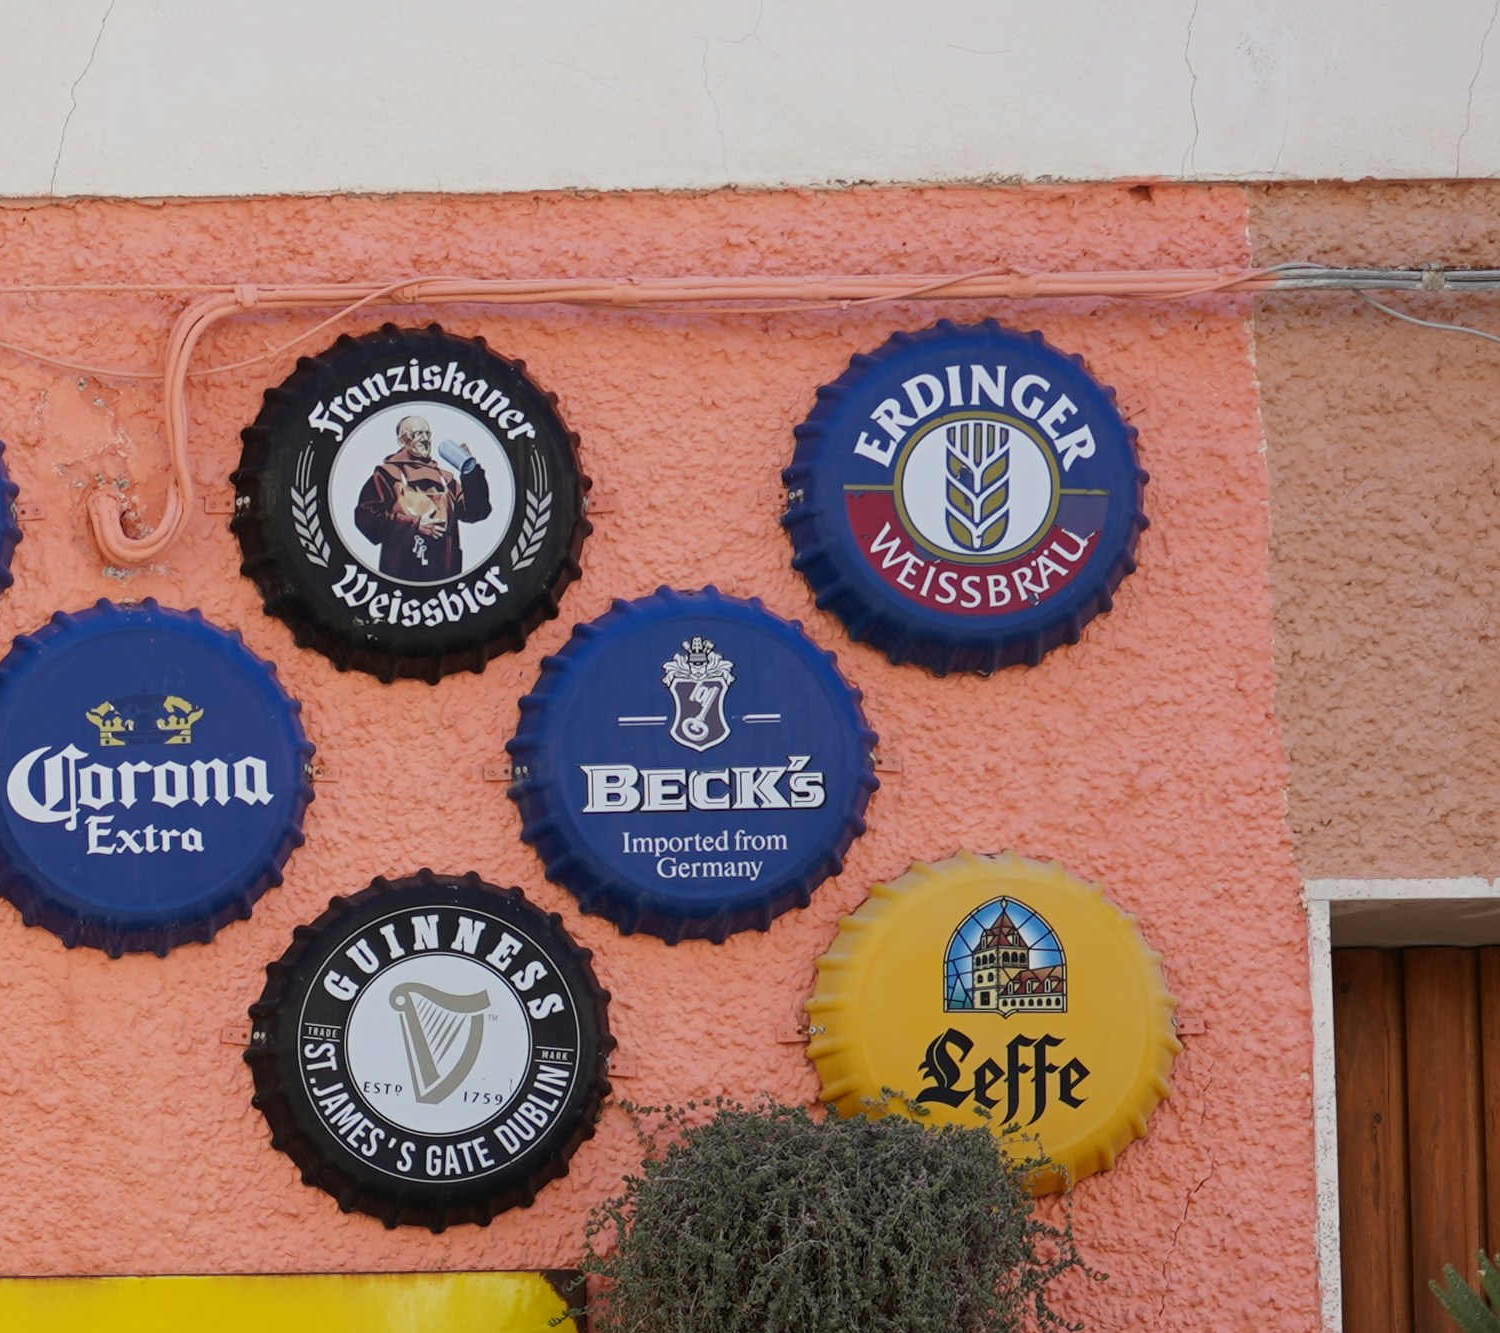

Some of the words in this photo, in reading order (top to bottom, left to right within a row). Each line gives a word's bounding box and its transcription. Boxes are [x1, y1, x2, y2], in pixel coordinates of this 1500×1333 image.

[308, 357, 537, 443] Franziskaner
[853, 364, 1096, 472] ERDINGER
[332, 563, 509, 628] Weissbier
[869, 520, 1093, 610] WEISSBRÄU
[7, 742, 274, 831] Corona
[85, 815, 204, 857] Extra
[622, 831, 727, 854] Imported
[734, 829, 788, 852] from
[655, 856, 763, 882] Germany
[323, 914, 566, 1021] GUINNESS
[308, 1026, 338, 1038] TRADE
[541, 1050, 569, 1061] MARK
[463, 1091, 504, 1105] 1759
[917, 1030, 1091, 1128] Leffe
[426, 1136, 495, 1177] GATE
[493, 1064, 571, 1155] DUBLIN
